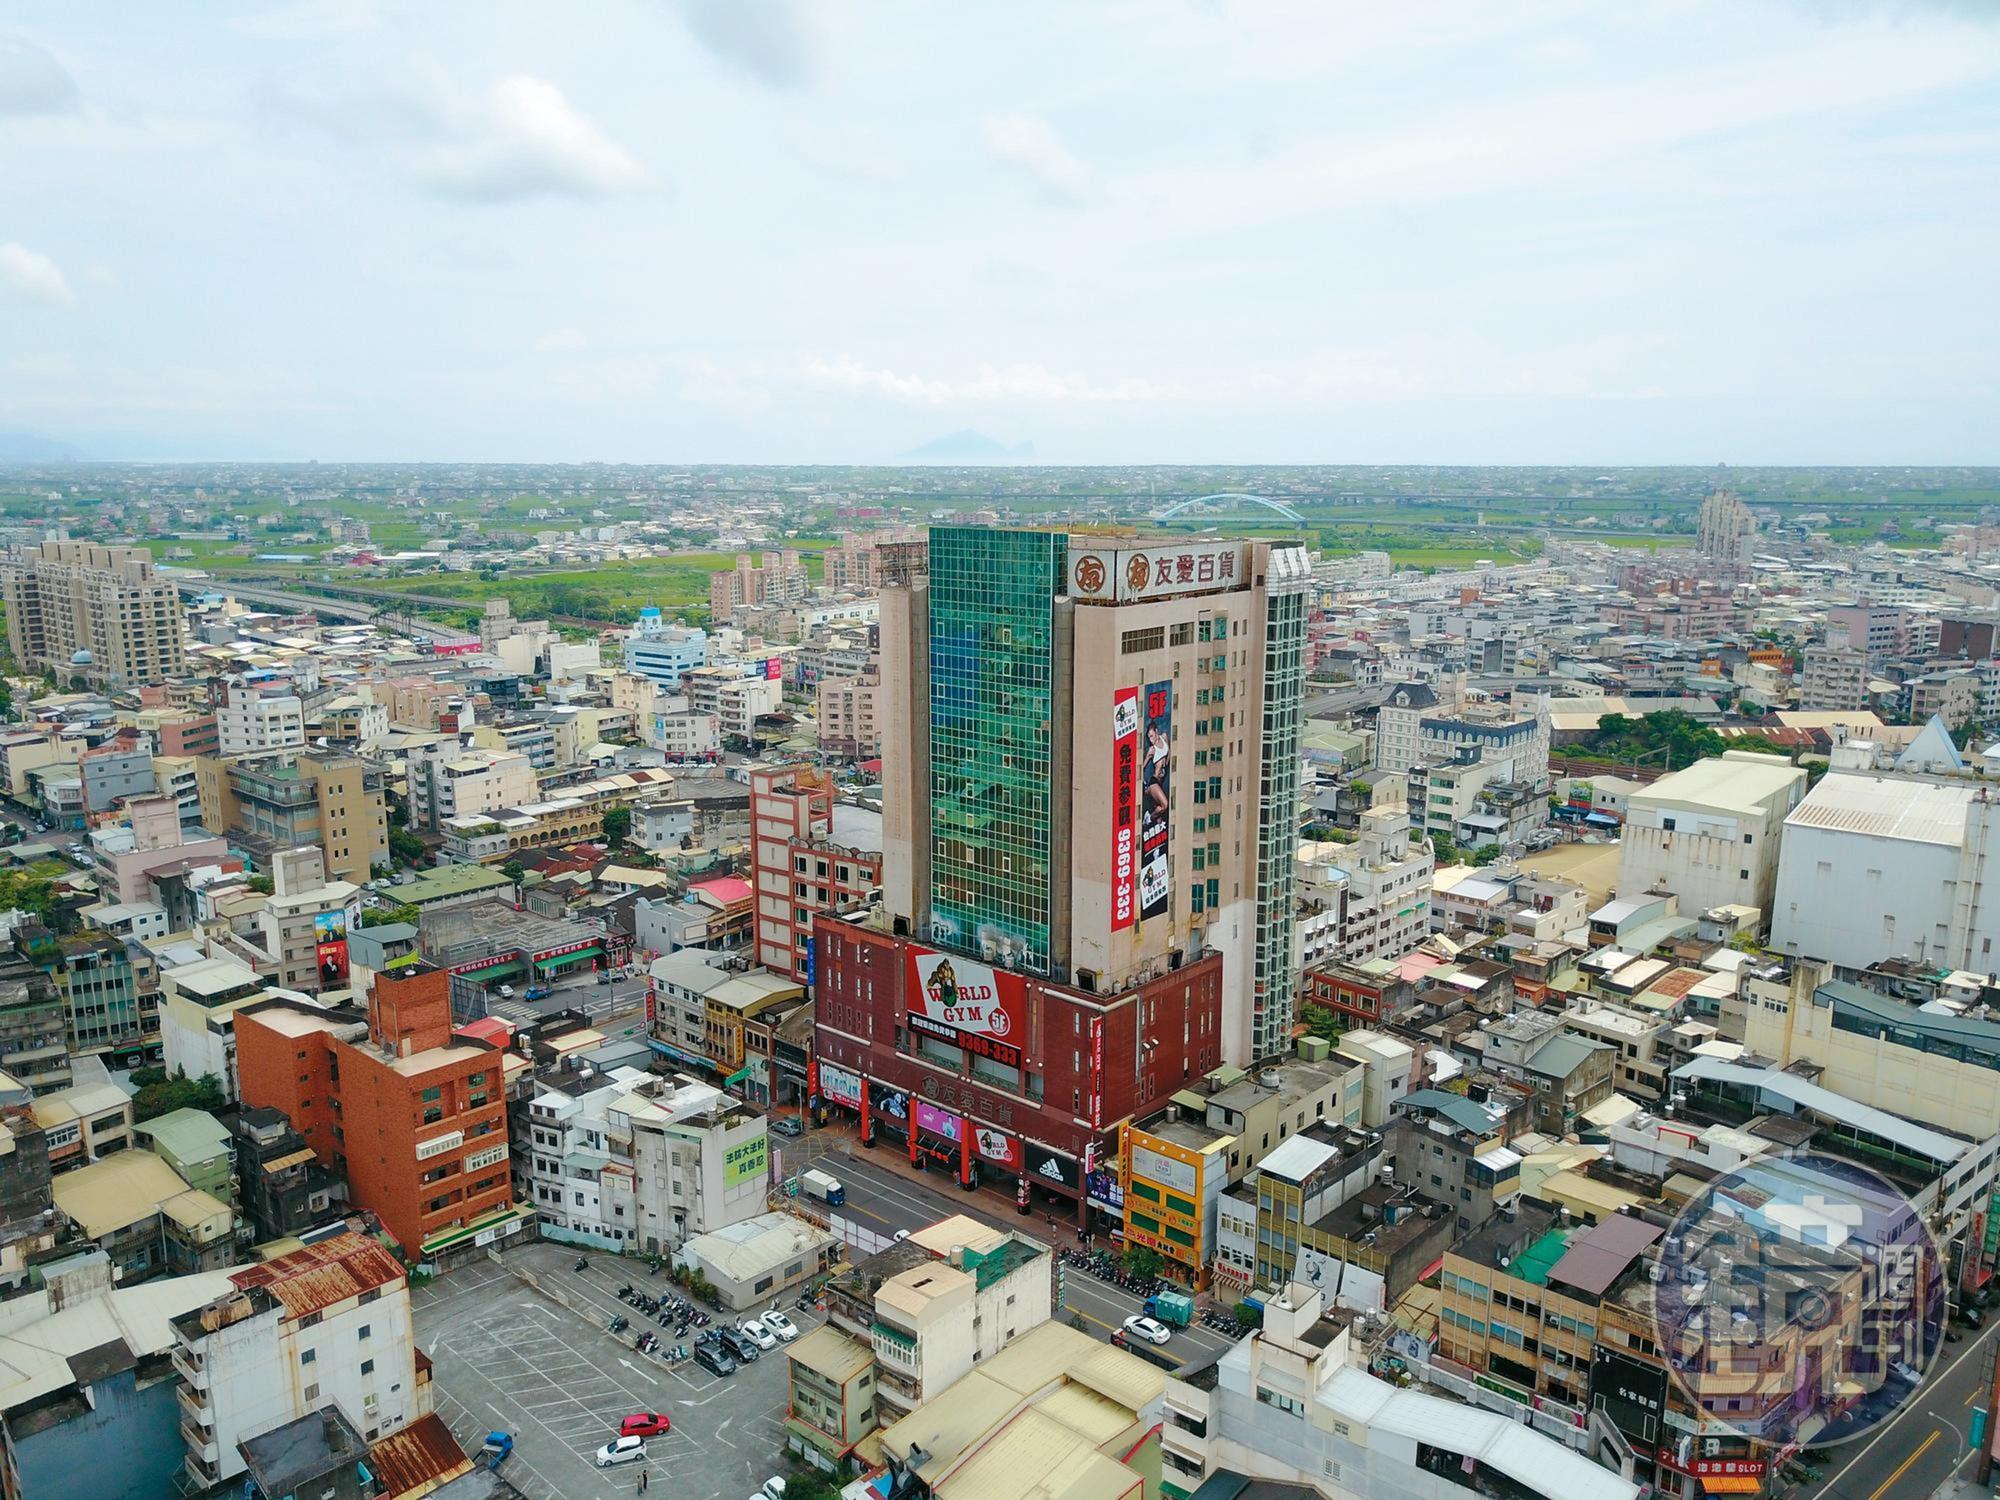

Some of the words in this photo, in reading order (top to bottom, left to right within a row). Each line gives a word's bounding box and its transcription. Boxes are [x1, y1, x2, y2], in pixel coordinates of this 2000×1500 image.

[1155, 550, 1235, 587] 友愛百貨
[1149, 691, 1167, 719] 5F
[1117, 828, 1131, 921] 9369-333
[943, 1006, 983, 1022] GYM
[992, 1012, 1006, 1031] 5F
[958, 1031, 1017, 1067] 9369-333
[943, 1084, 1014, 1127] 友愛百貨
[1039, 1166, 1064, 1182] adidas
[1738, 1463, 1763, 1474] SLOT
